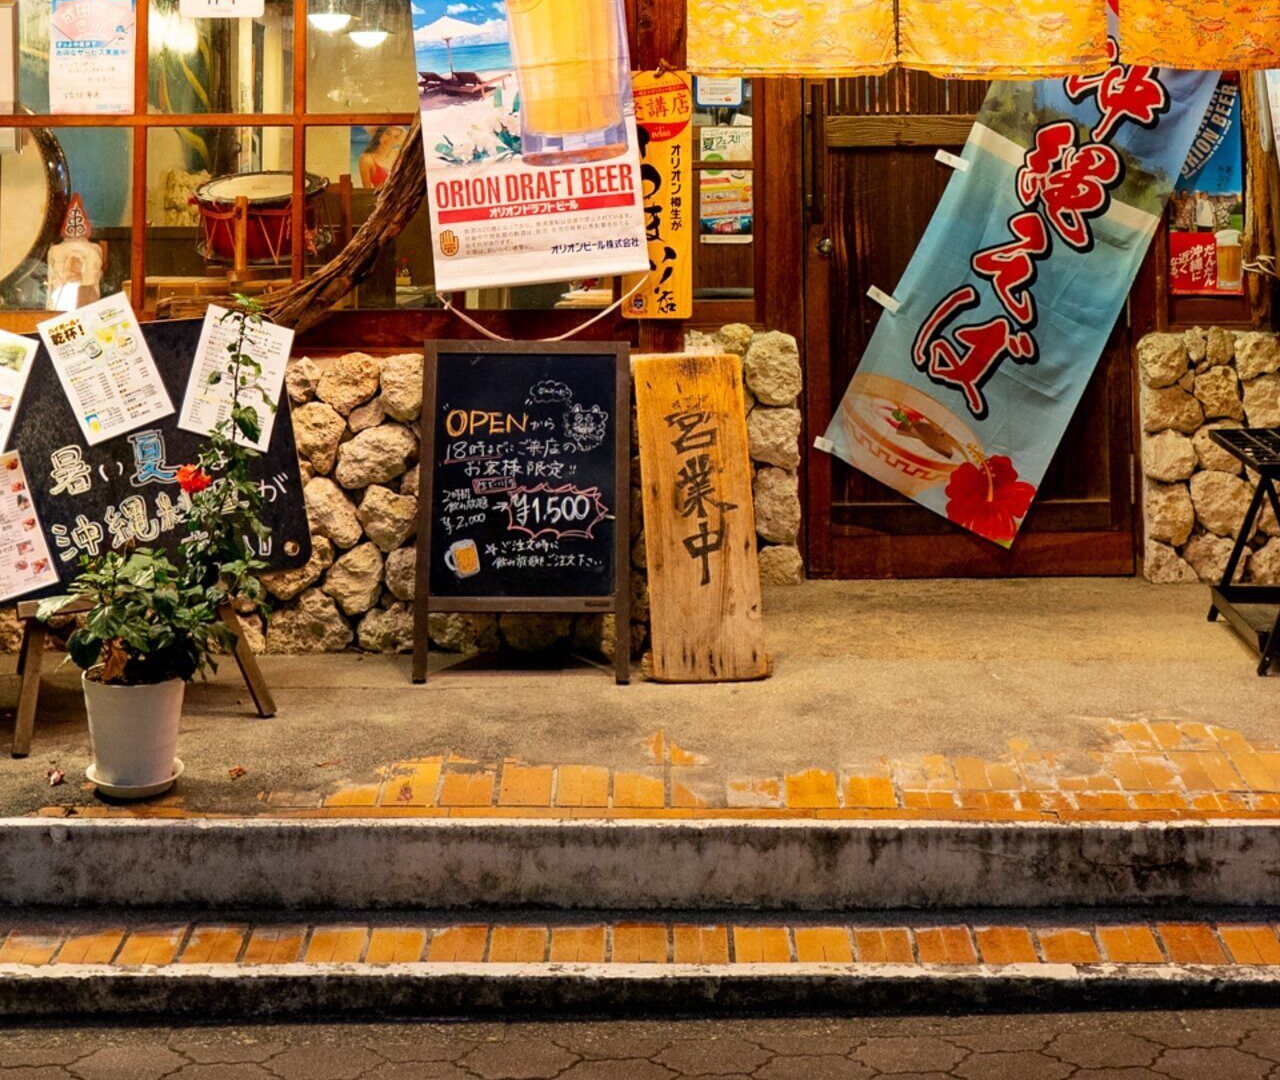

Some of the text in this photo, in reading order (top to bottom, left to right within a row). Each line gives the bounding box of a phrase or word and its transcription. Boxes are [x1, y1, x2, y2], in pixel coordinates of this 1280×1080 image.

[435, 163, 634, 209] ORION DRAFT BEER
[489, 200, 579, 218] オリオンドラフトビール
[670, 144, 682, 232] オリオン樽生が
[551, 237, 639, 255] オリオンビール株式会社
[663, 394, 738, 586] 営業中
